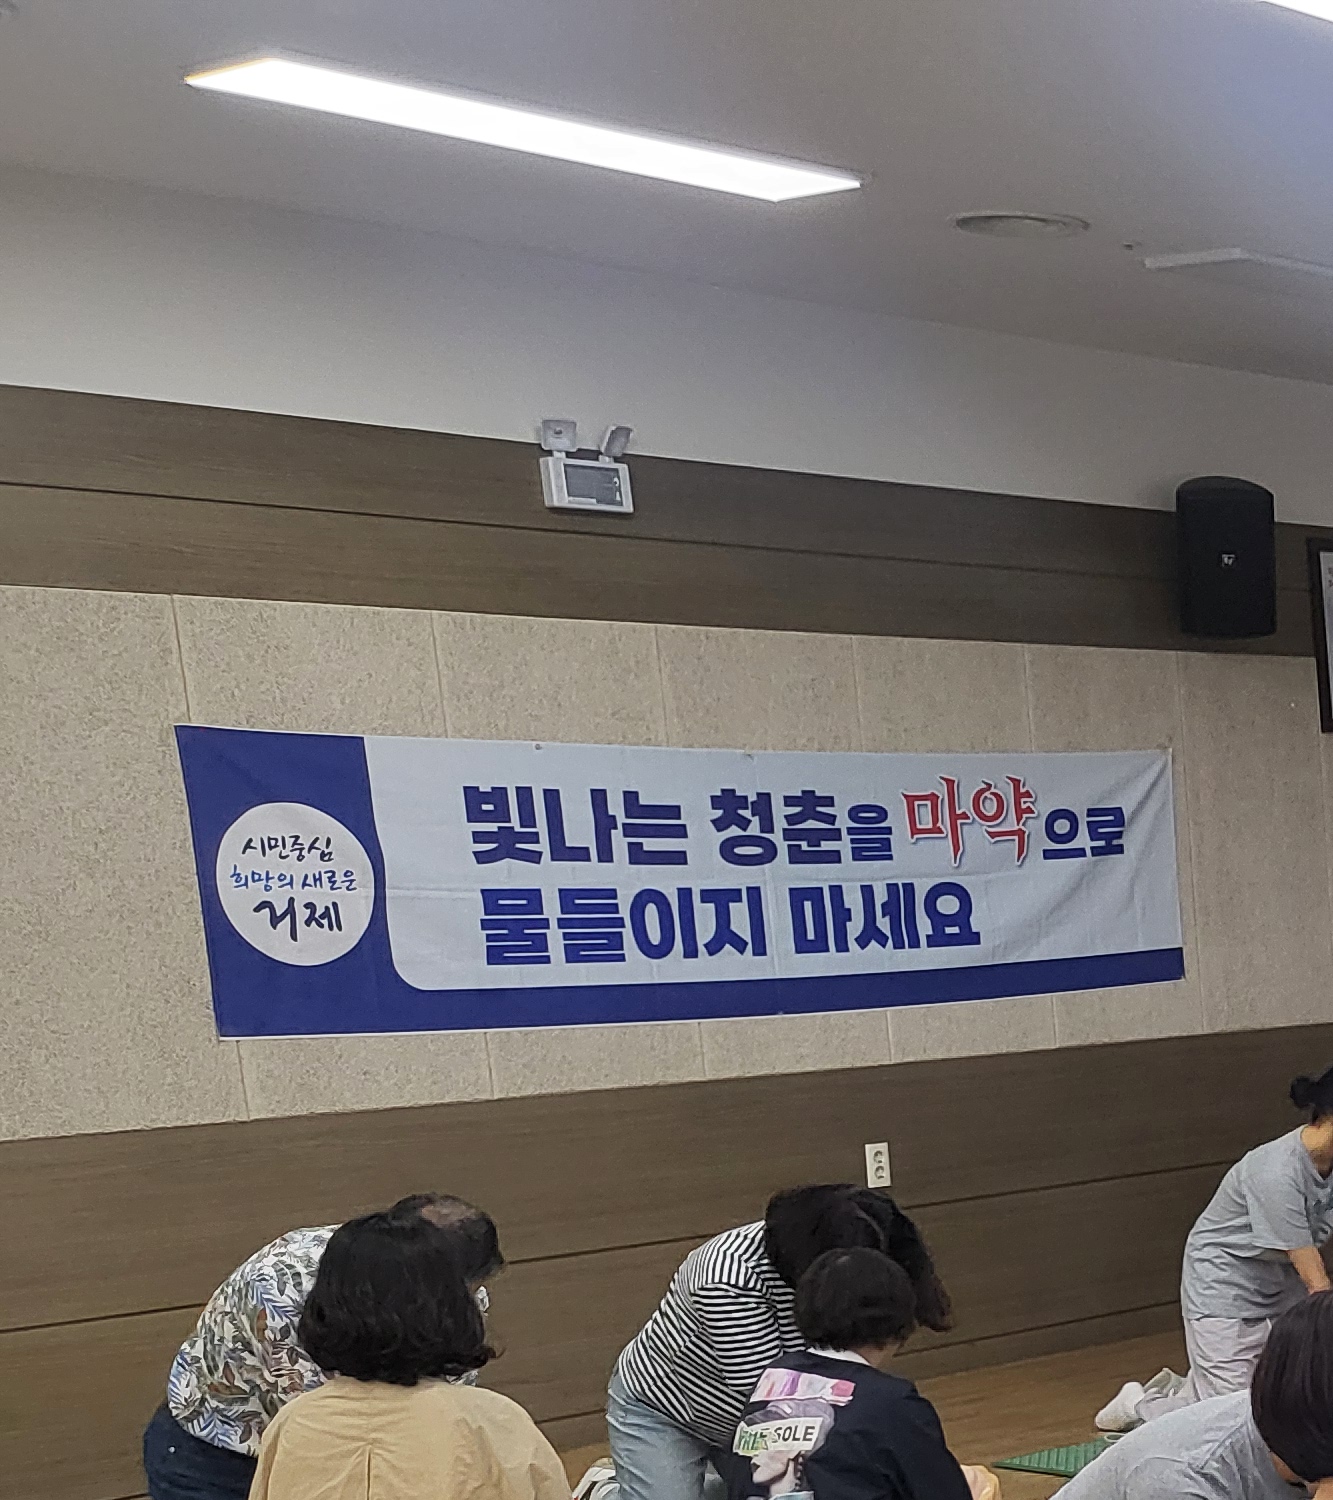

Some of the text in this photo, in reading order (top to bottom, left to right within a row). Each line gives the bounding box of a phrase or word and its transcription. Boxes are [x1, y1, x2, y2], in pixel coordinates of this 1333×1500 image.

[461, 775, 1127, 868] 빛나는 청춘을 마약으로
[241, 834, 335, 863] 시민중심
[230, 863, 358, 893] 희망의 새로운
[252, 896, 344, 943] 거제
[478, 881, 981, 966] 물들이지 마세요
[772, 1424, 816, 1444] SOLE
